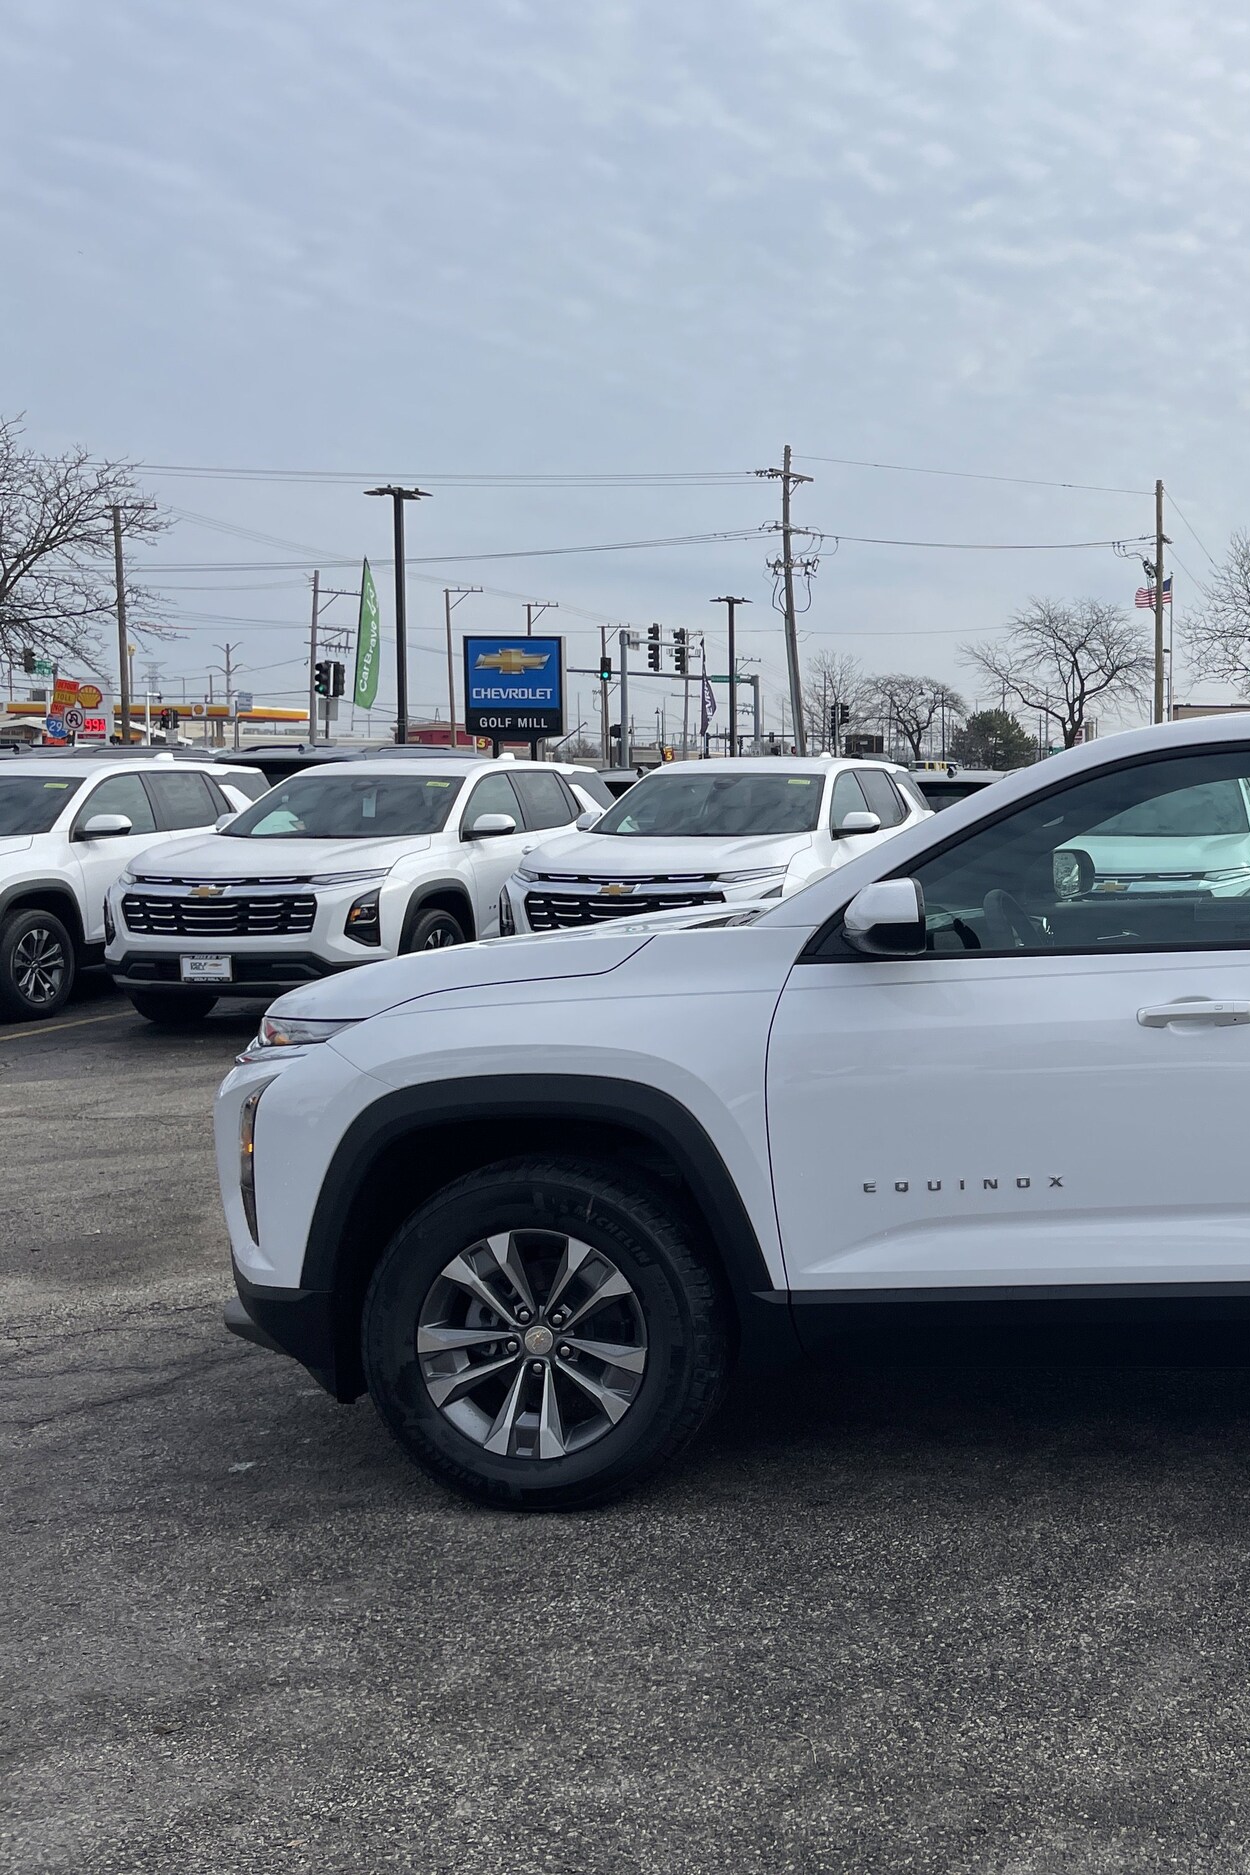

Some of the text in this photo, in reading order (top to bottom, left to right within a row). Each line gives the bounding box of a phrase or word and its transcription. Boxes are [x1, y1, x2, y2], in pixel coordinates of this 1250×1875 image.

[359, 620, 378, 692] CarBravo
[57, 693, 72, 702] TOLL
[472, 687, 553, 700] CHEVROLET
[479, 717, 548, 728] GOLF MILL
[477, 738, 486, 748] 5
[666, 752, 674, 761] 5
[863, 1175, 1064, 1194] EQUINOX
